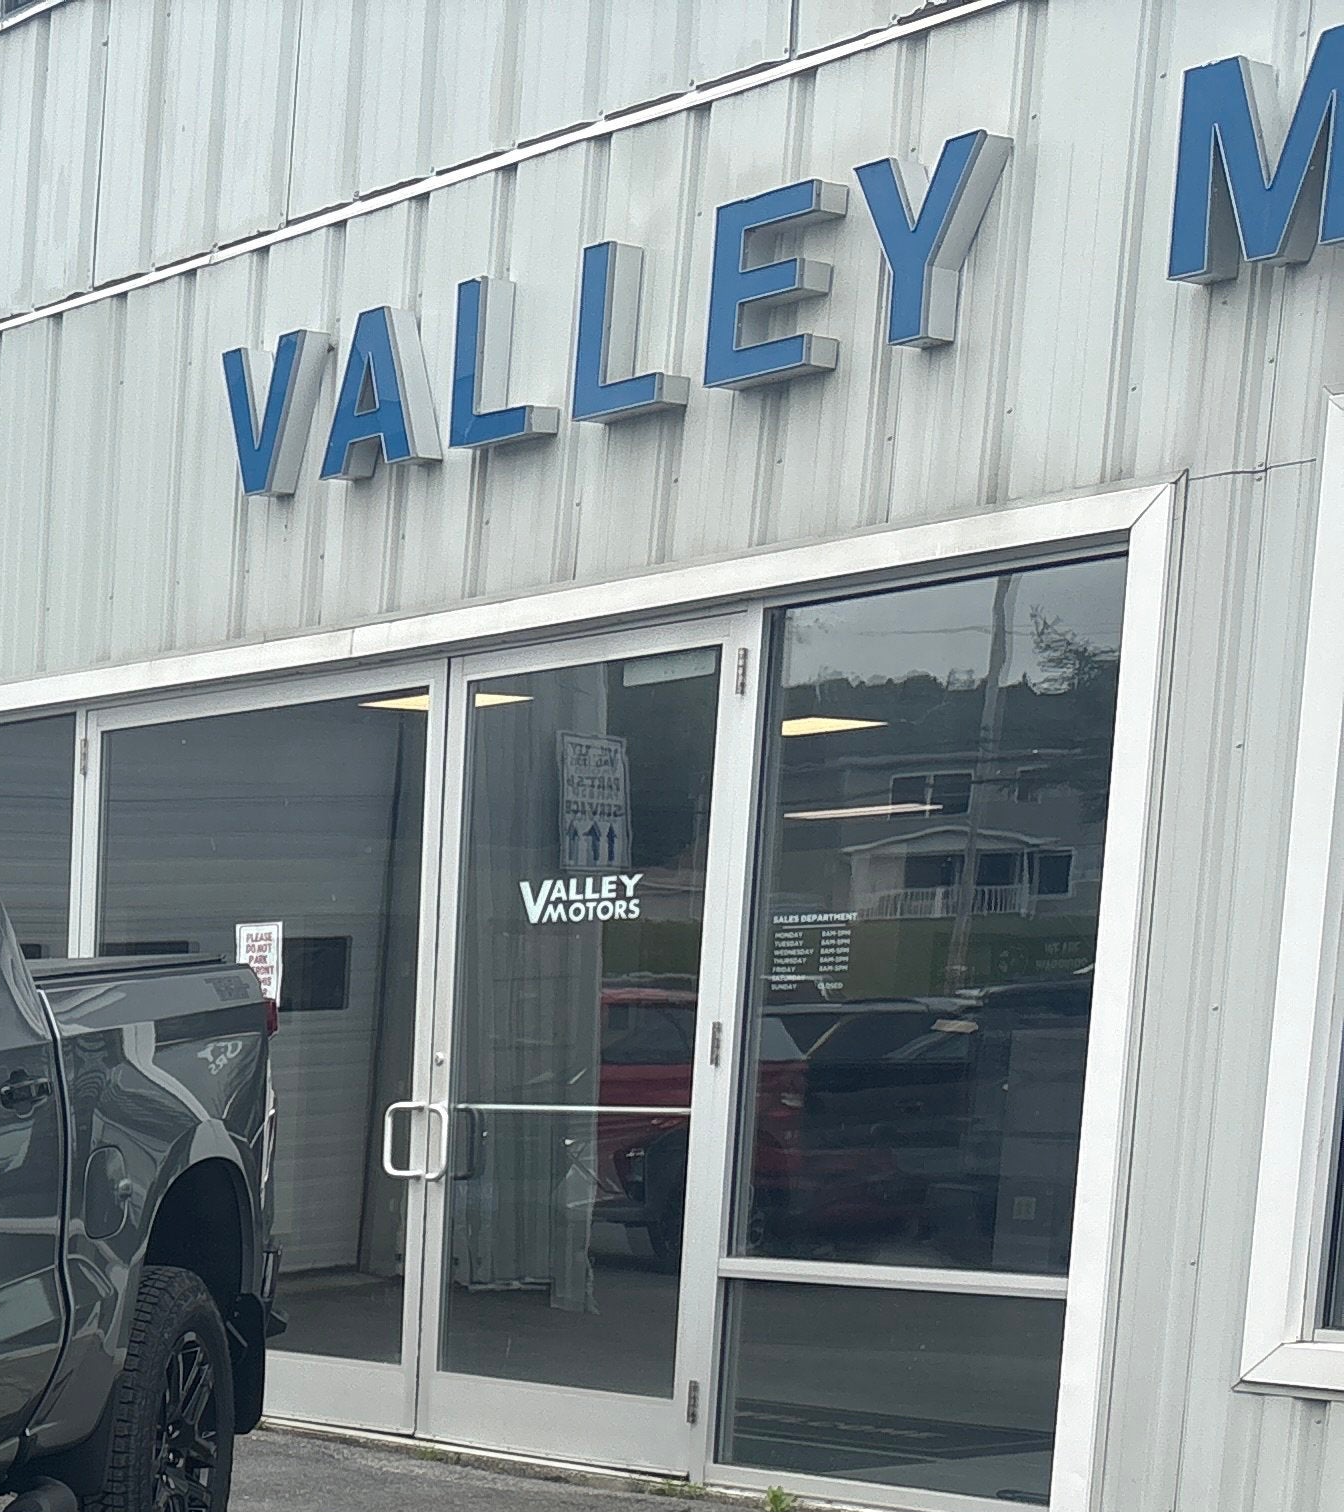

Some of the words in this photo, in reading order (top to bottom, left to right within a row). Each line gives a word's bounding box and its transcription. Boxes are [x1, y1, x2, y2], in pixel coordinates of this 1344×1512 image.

[222, 129, 1014, 497] VALLEY
[519, 873, 644, 924] VALLEY
[541, 898, 641, 923] MOTORS
[773, 915, 800, 924] SALES
[801, 912, 858, 923] DEPARTMENT
[246, 932, 272, 943] PLEASE
[246, 943, 256, 953] DO
[257, 943, 272, 953] NOT
[249, 954, 268, 965] PARK
